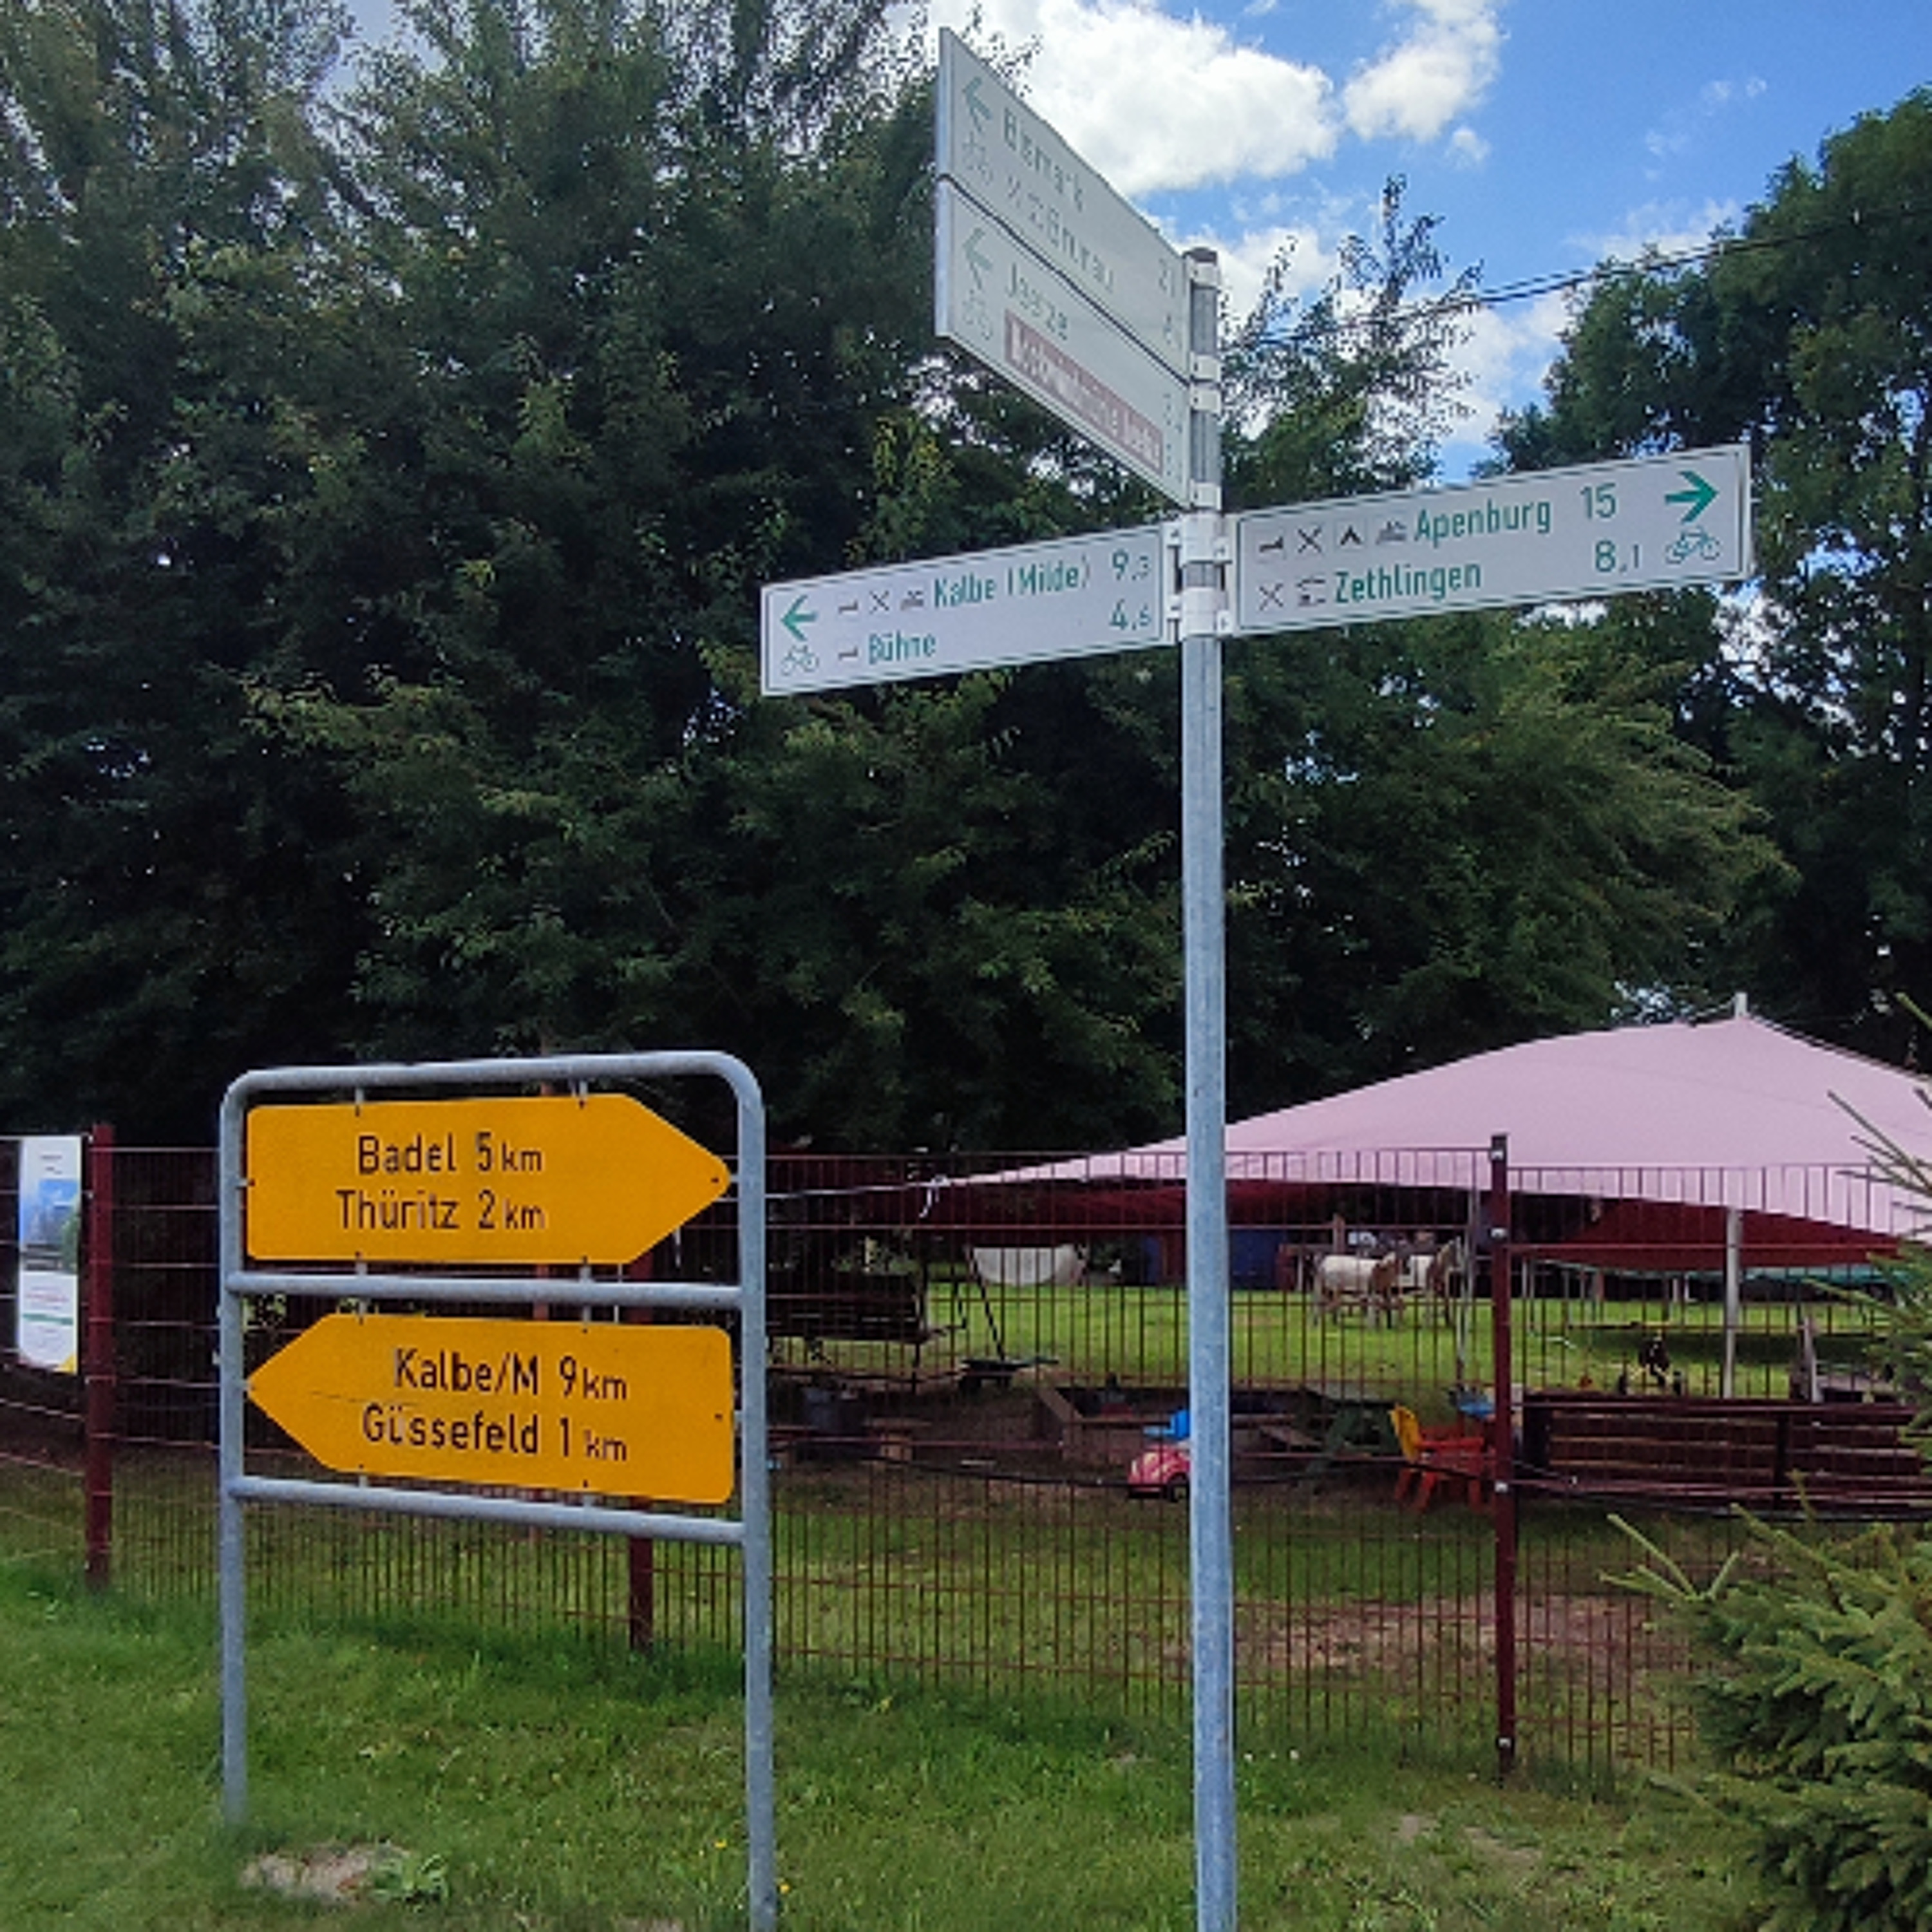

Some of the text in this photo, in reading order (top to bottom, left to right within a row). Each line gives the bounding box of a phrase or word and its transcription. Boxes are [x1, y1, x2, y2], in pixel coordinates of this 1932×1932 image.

[1414, 483, 1616, 545] Apenburg 15
[933, 574, 997, 609] Kalbe
[1007, 554, 1090, 595] (Milde)
[1334, 560, 1481, 605] Zethlingen
[868, 632, 936, 666] Bühne
[357, 1133, 544, 1175] Badel 5 km
[336, 1189, 545, 1231] Thüritz 2 km
[393, 1347, 628, 1401] Kalbe/M 9 km
[362, 1404, 628, 1463] Güssefeld 1 km
